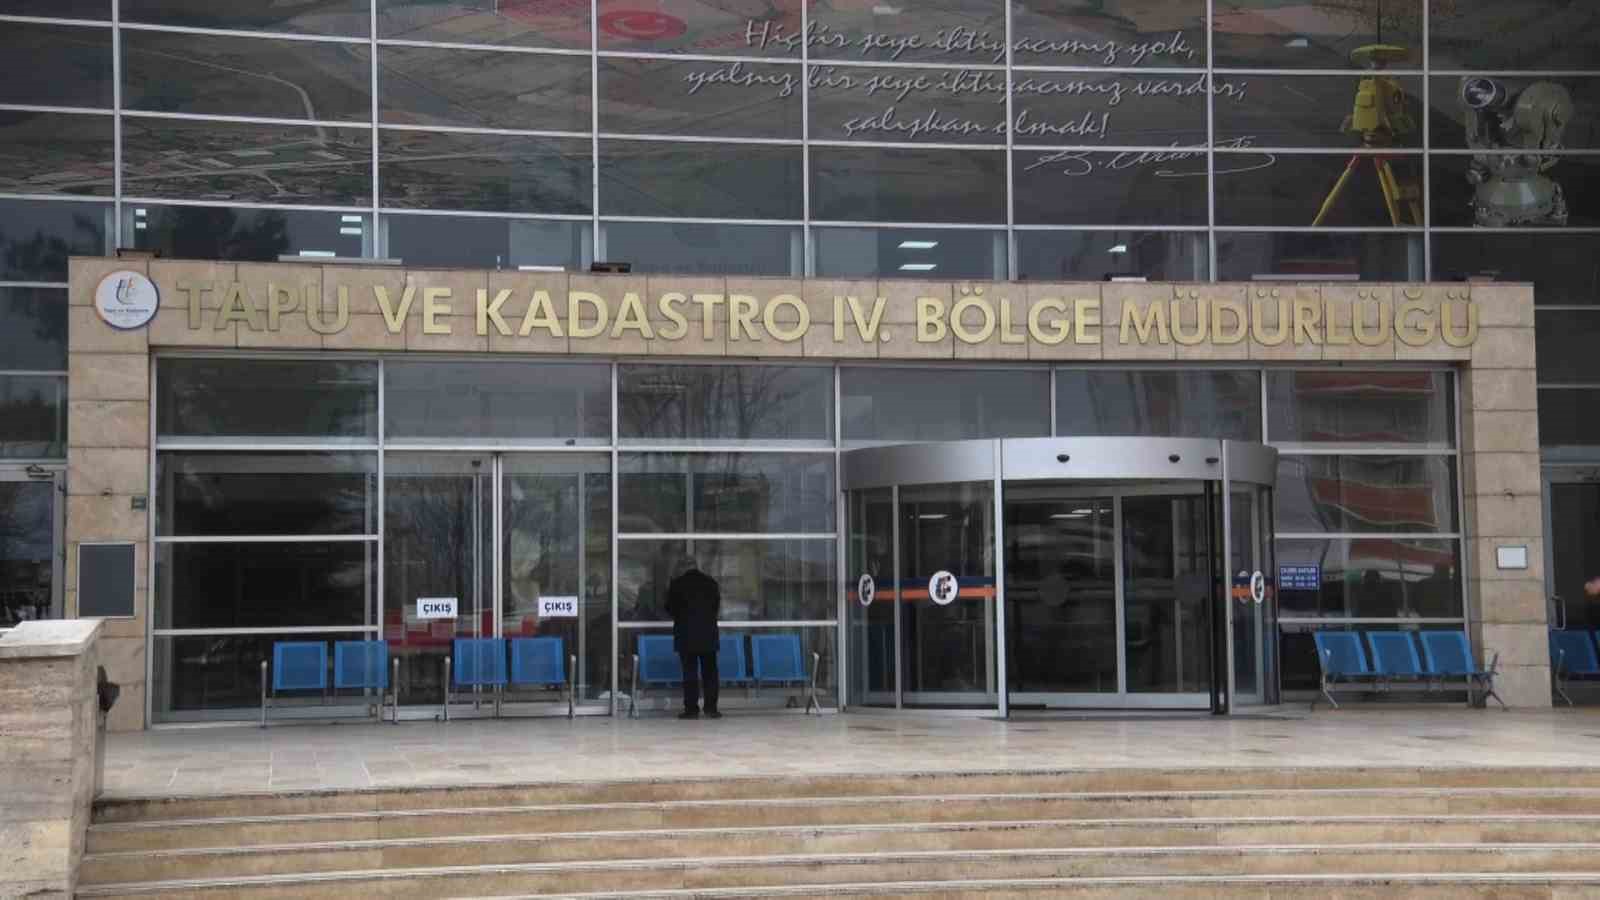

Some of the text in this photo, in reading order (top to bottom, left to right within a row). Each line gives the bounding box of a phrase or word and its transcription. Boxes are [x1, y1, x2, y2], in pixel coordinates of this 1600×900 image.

[745, 18, 1195, 64] Hiçbir şeye ihtiyacımız yok,
[684, 62, 800, 97] yalnız
[805, 64, 857, 90] bir
[862, 74, 930, 103] şeye
[934, 69, 1128, 105] ihtiyacımız
[842, 106, 1110, 138] çalışkan olmak!
[175, 279, 1480, 347] TAPU VE KADASTRO IV. BÖLGE MÜDÜRLÜĞÜ
[423, 603, 452, 614] ÇIKIŞ
[544, 601, 573, 611] ÇIKIŞ
